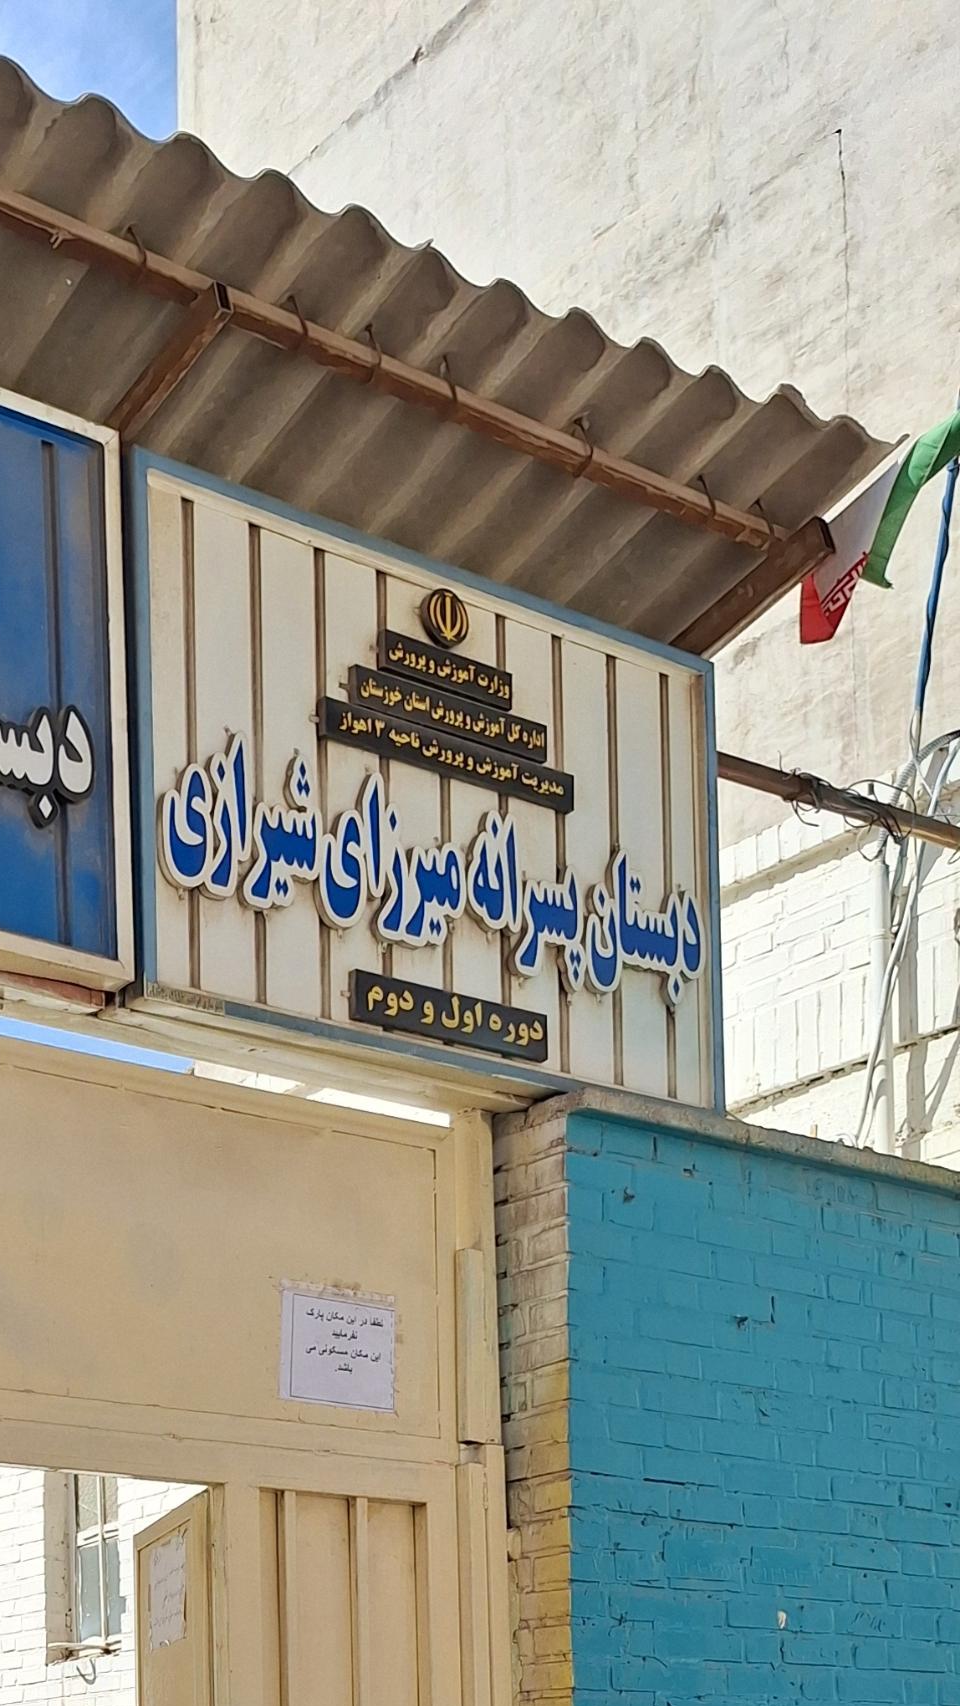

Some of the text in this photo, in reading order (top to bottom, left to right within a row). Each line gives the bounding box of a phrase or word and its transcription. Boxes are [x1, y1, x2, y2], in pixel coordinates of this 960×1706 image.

[388, 641, 511, 699] وزارت آموزش و پرورش
[360, 677, 545, 749] اداره کل آموزش و پرورش استان خوزستان
[339, 711, 564, 796] مدیریت آموزش و پرورش ناحیه ۳ اهواز
[167, 741, 702, 1001] دبستان پسرانه میرزای شیرازی
[366, 988, 545, 1048] دوره اول و دوم
[305, 1307, 325, 1322] پارک
[326, 1312, 345, 1323] مکان
[346, 1314, 357, 1325] این
[359, 1318, 368, 1327] در
[331, 1329, 358, 1341] نفرمایید
[305, 1344, 381, 1362] این مکان مسکونی می
